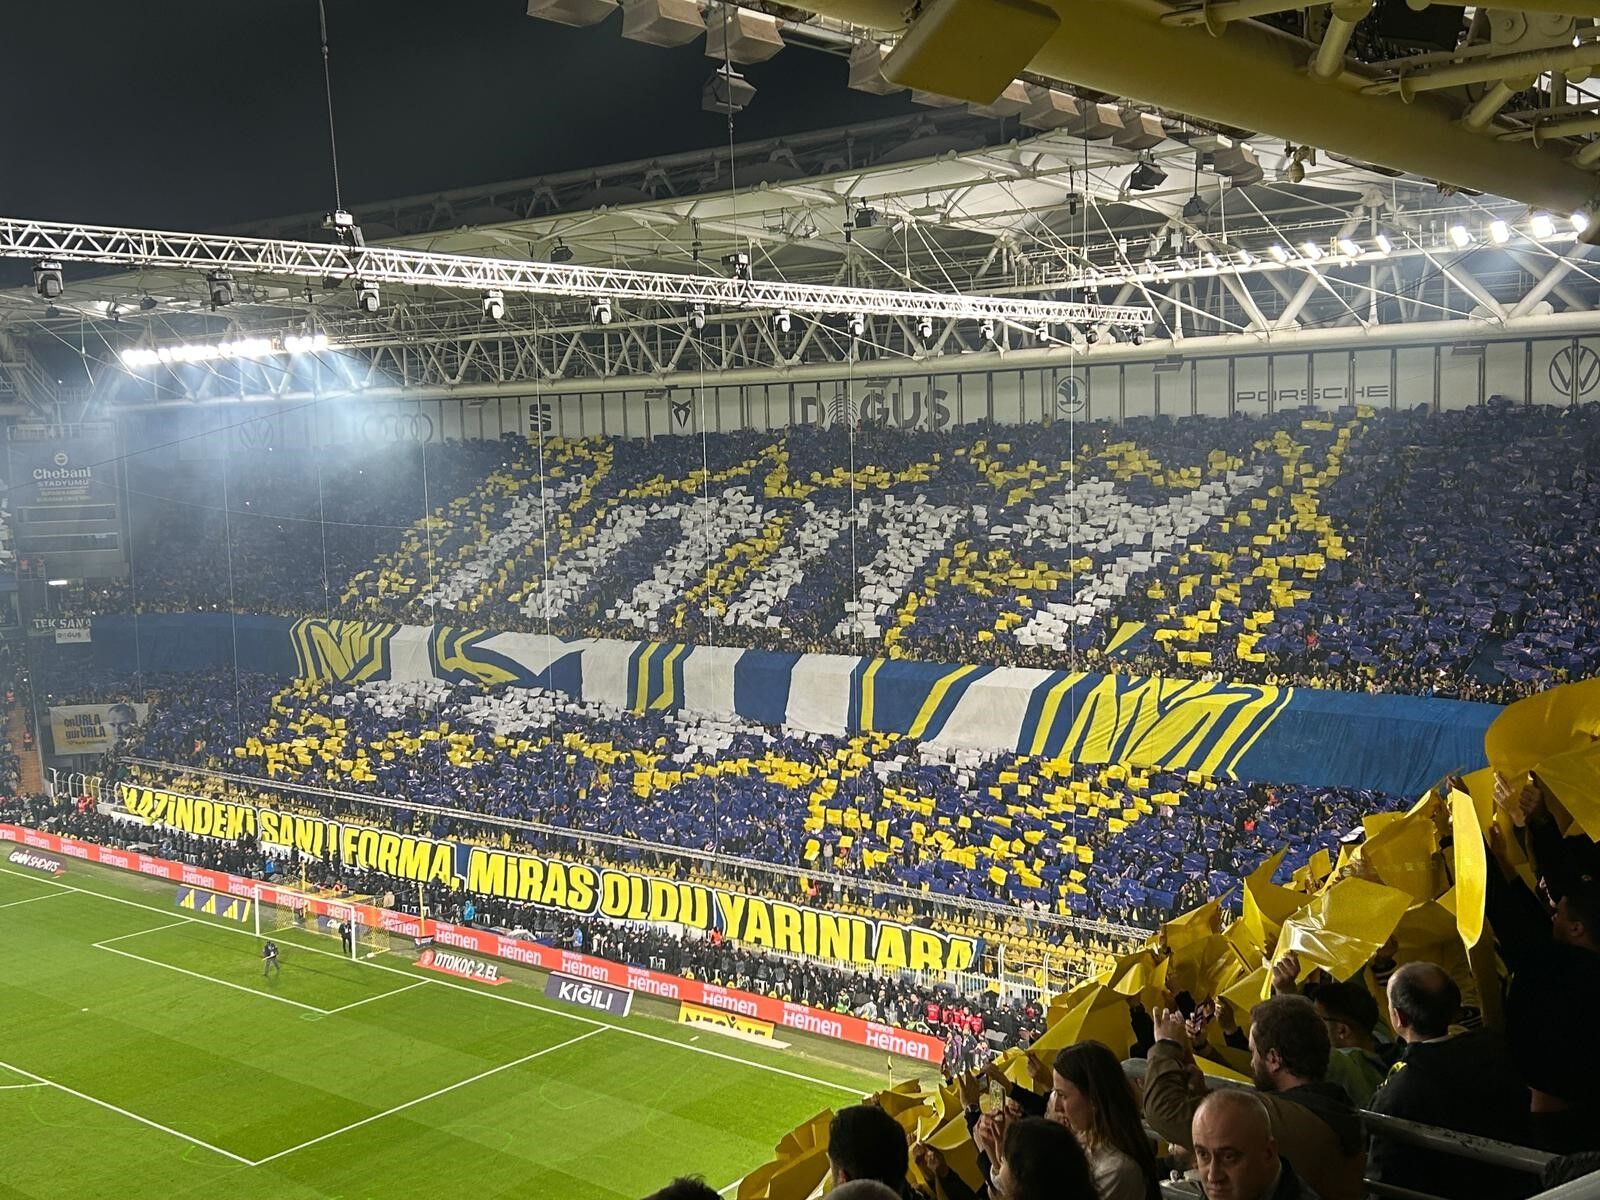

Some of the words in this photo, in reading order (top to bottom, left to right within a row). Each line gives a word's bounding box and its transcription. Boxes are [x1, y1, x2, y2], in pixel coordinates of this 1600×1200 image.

[1237, 385, 1389, 402] PORSCHE
[32, 467, 92, 480] Chobani
[33, 618, 57, 629] TEK
[139, 861, 169, 878] Hemen
[182, 871, 215, 889] Hemen
[469, 850, 595, 911] MİRAS
[600, 872, 709, 930] OLDU
[717, 891, 973, 972] YARINLARA
[435, 927, 478, 950] Hemen
[624, 920, 668, 935] Chobni
[497, 942, 542, 966] Hemen
[562, 958, 609, 982] Hemen
[627, 974, 679, 999] Hemen
[702, 990, 758, 1017] Hemen
[782, 1010, 842, 1039] Hemen
[866, 1030, 929, 1060] Hemen
